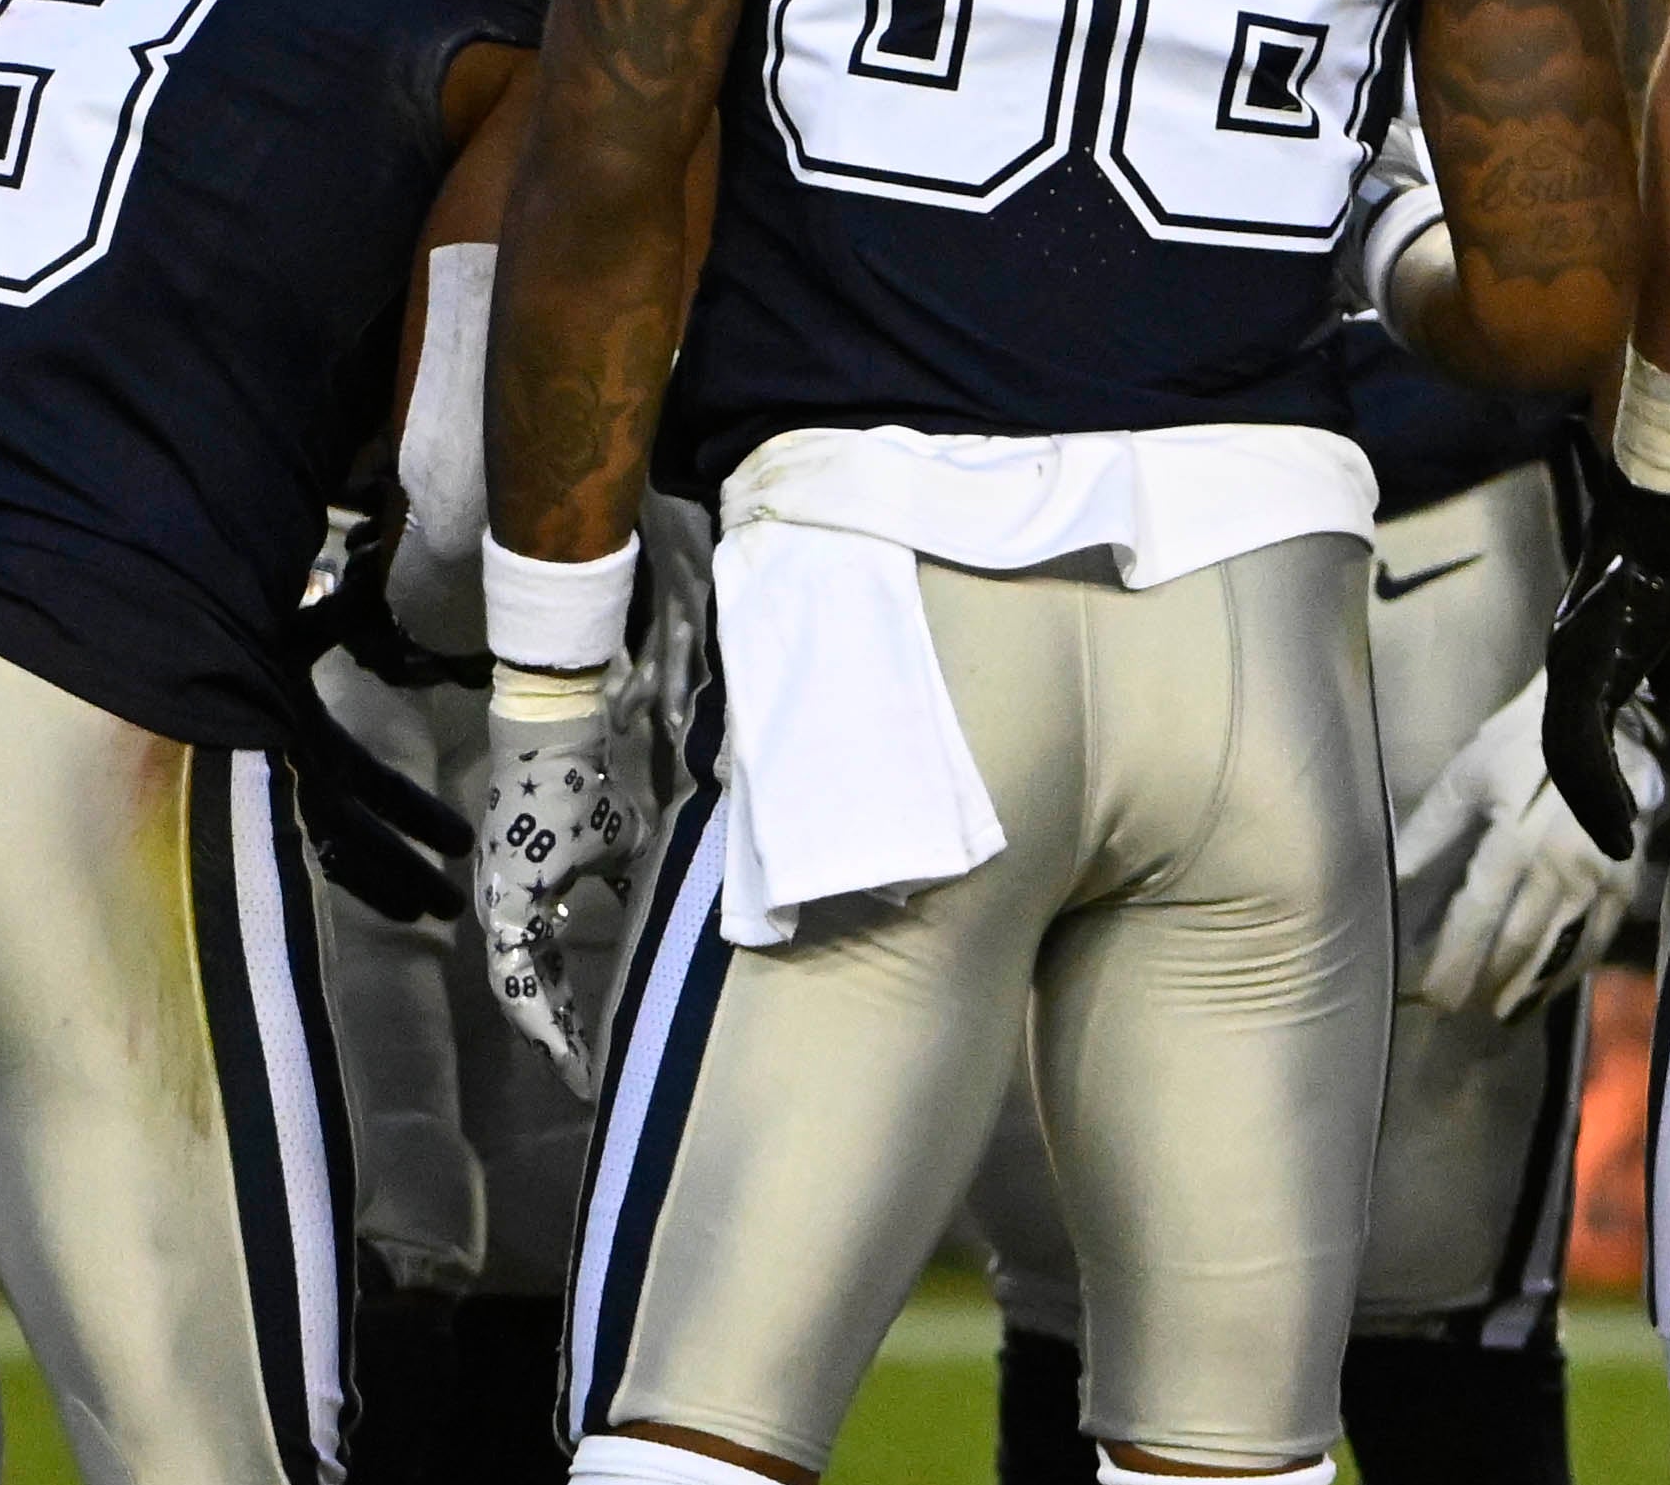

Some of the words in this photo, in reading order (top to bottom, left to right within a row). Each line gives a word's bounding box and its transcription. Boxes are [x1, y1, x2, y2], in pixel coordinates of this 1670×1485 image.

[506, 812, 556, 863] 88
[590, 797, 622, 845] 88
[505, 975, 538, 999] 88
